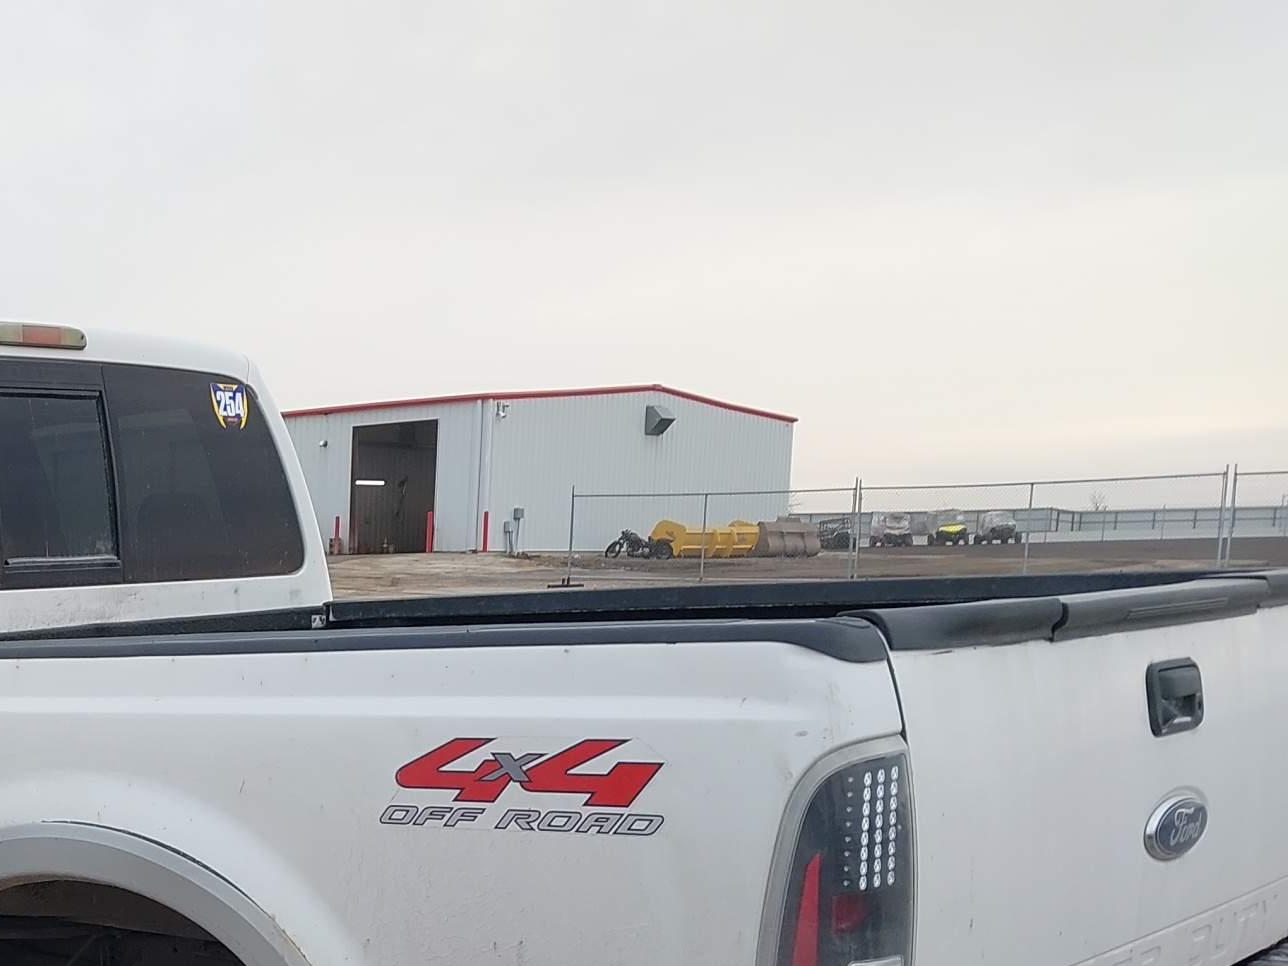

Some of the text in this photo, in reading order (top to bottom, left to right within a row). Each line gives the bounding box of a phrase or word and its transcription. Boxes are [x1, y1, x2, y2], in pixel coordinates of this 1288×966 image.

[215, 390, 245, 417] 254
[379, 804, 665, 836] OFF ROAD
[1169, 806, 1202, 846] Ford
